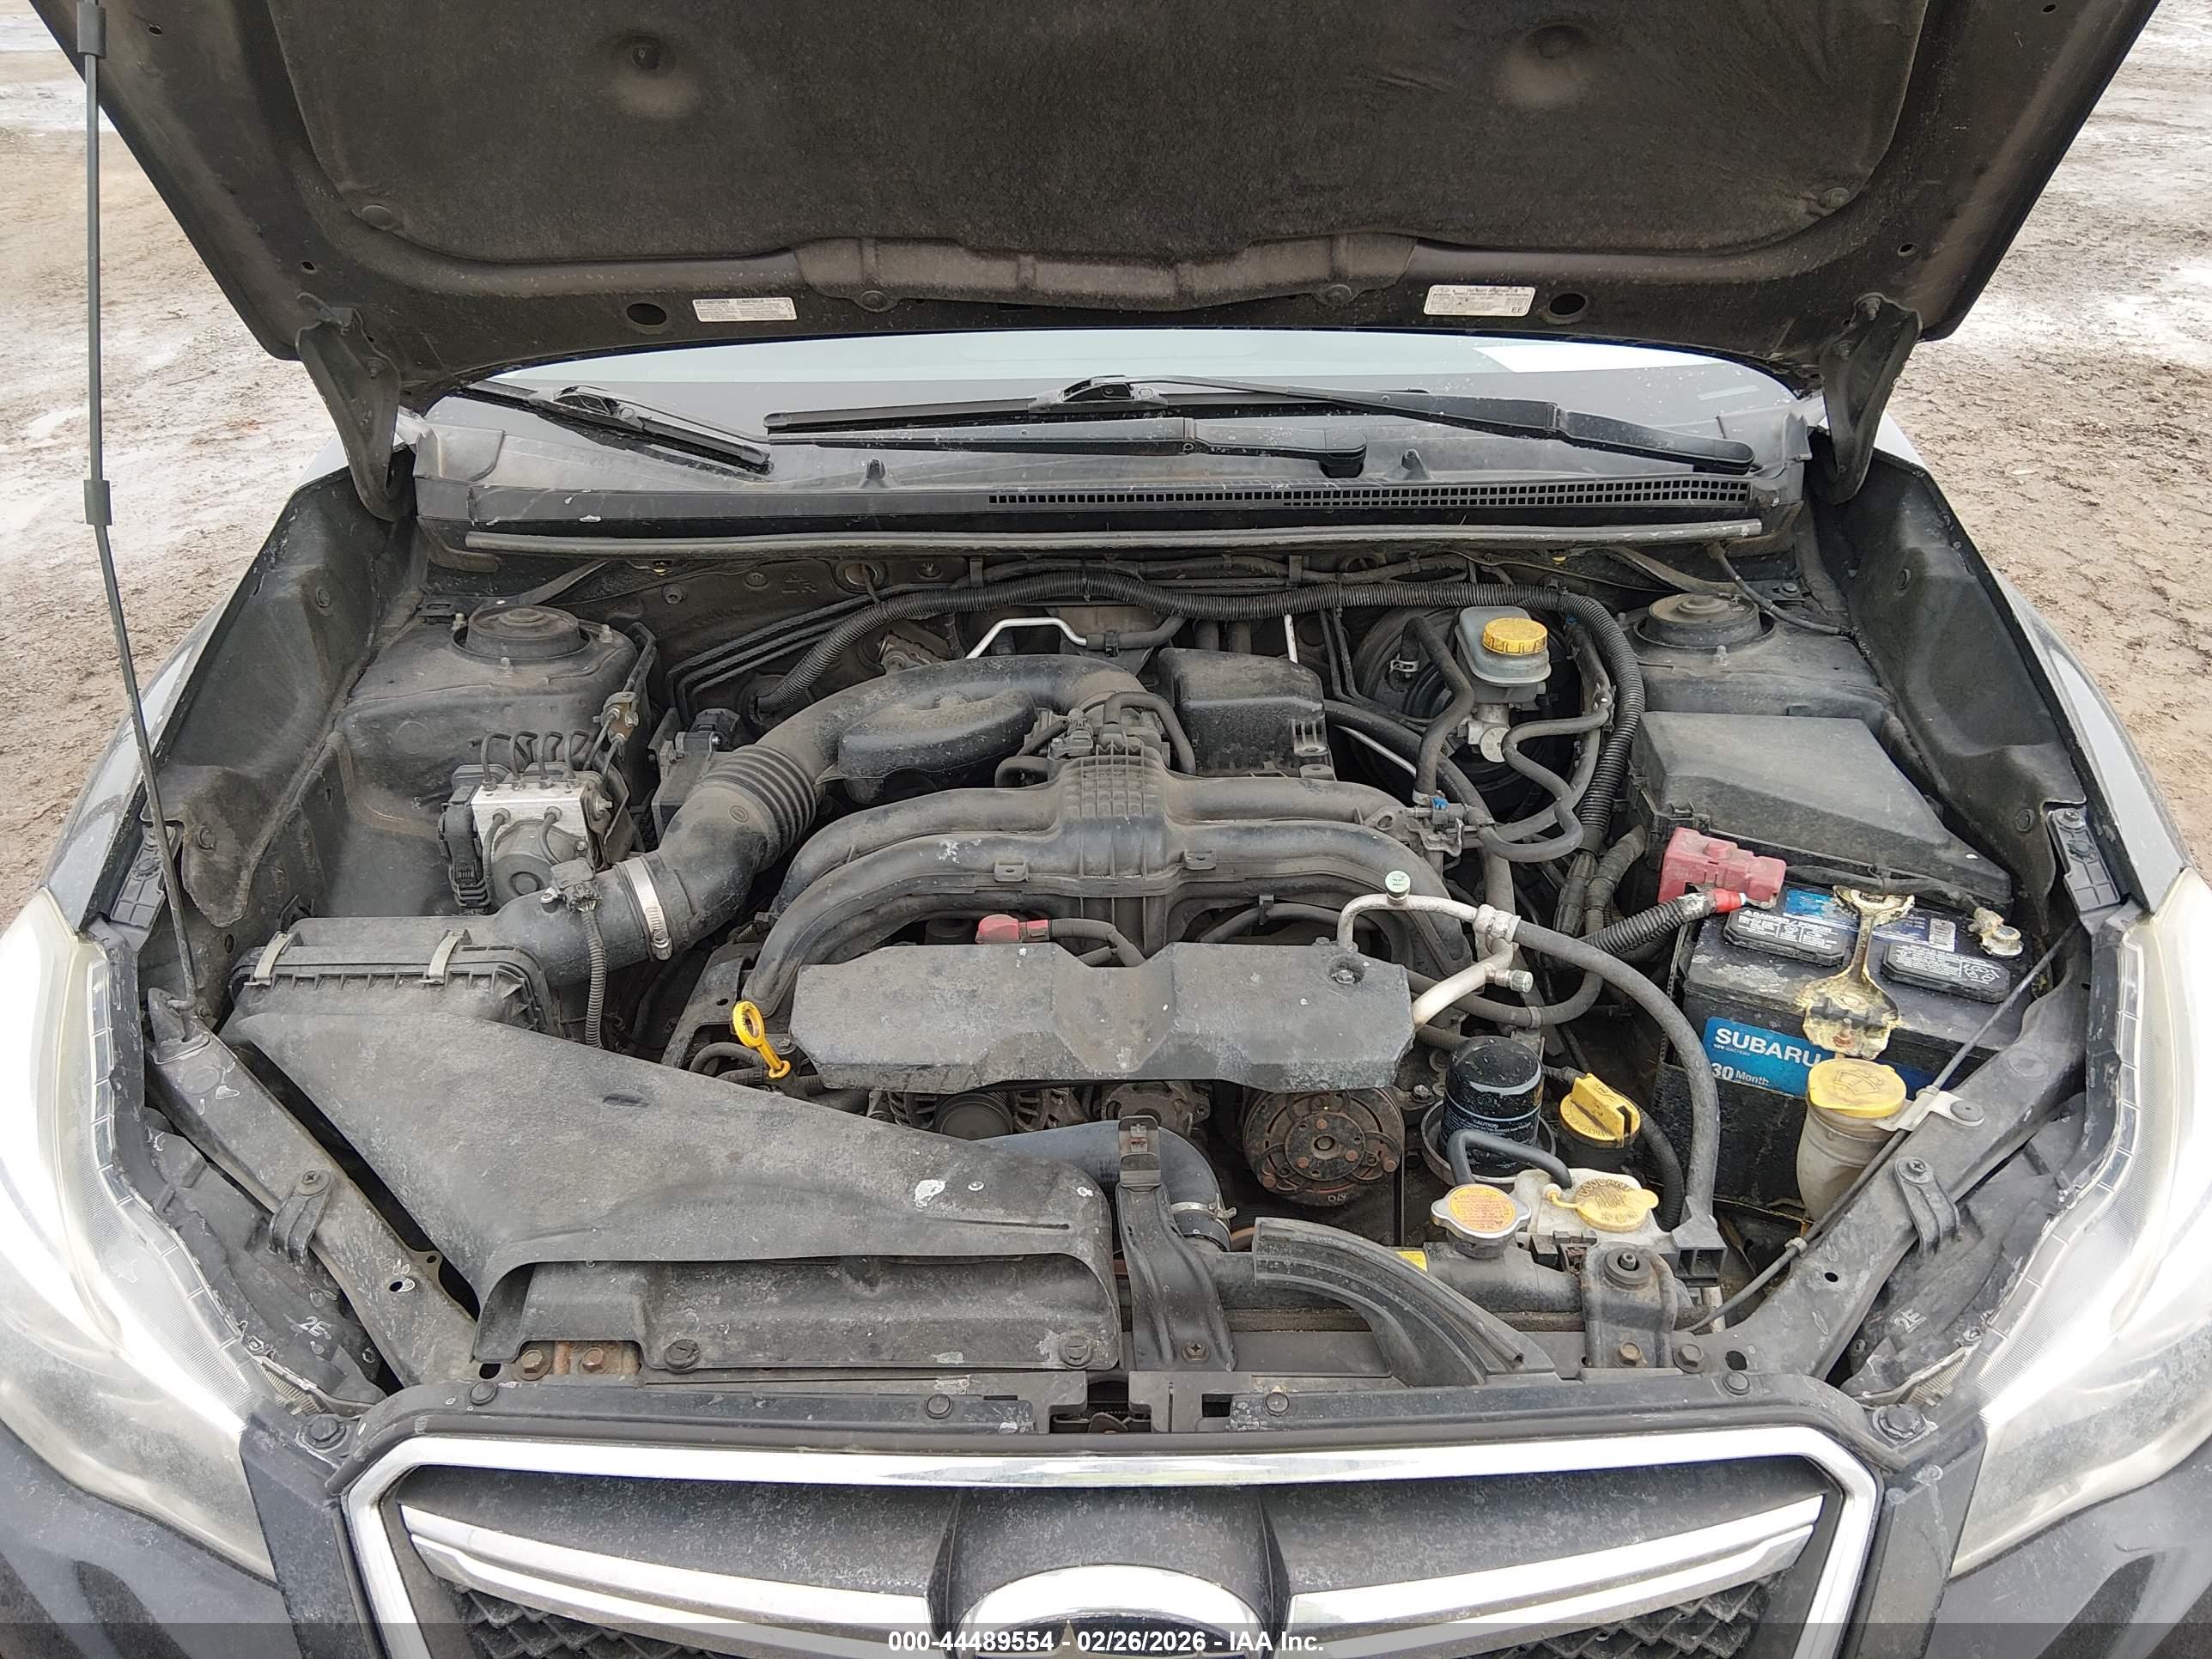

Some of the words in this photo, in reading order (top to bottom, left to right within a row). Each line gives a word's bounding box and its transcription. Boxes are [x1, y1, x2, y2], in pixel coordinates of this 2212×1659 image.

[1715, 1027, 1821, 1068] SUBARU
[1711, 1062, 1735, 1080] 30
[1473, 1118, 1499, 1129] CAUTION
[1580, 1179, 1634, 1197] COOLANT
